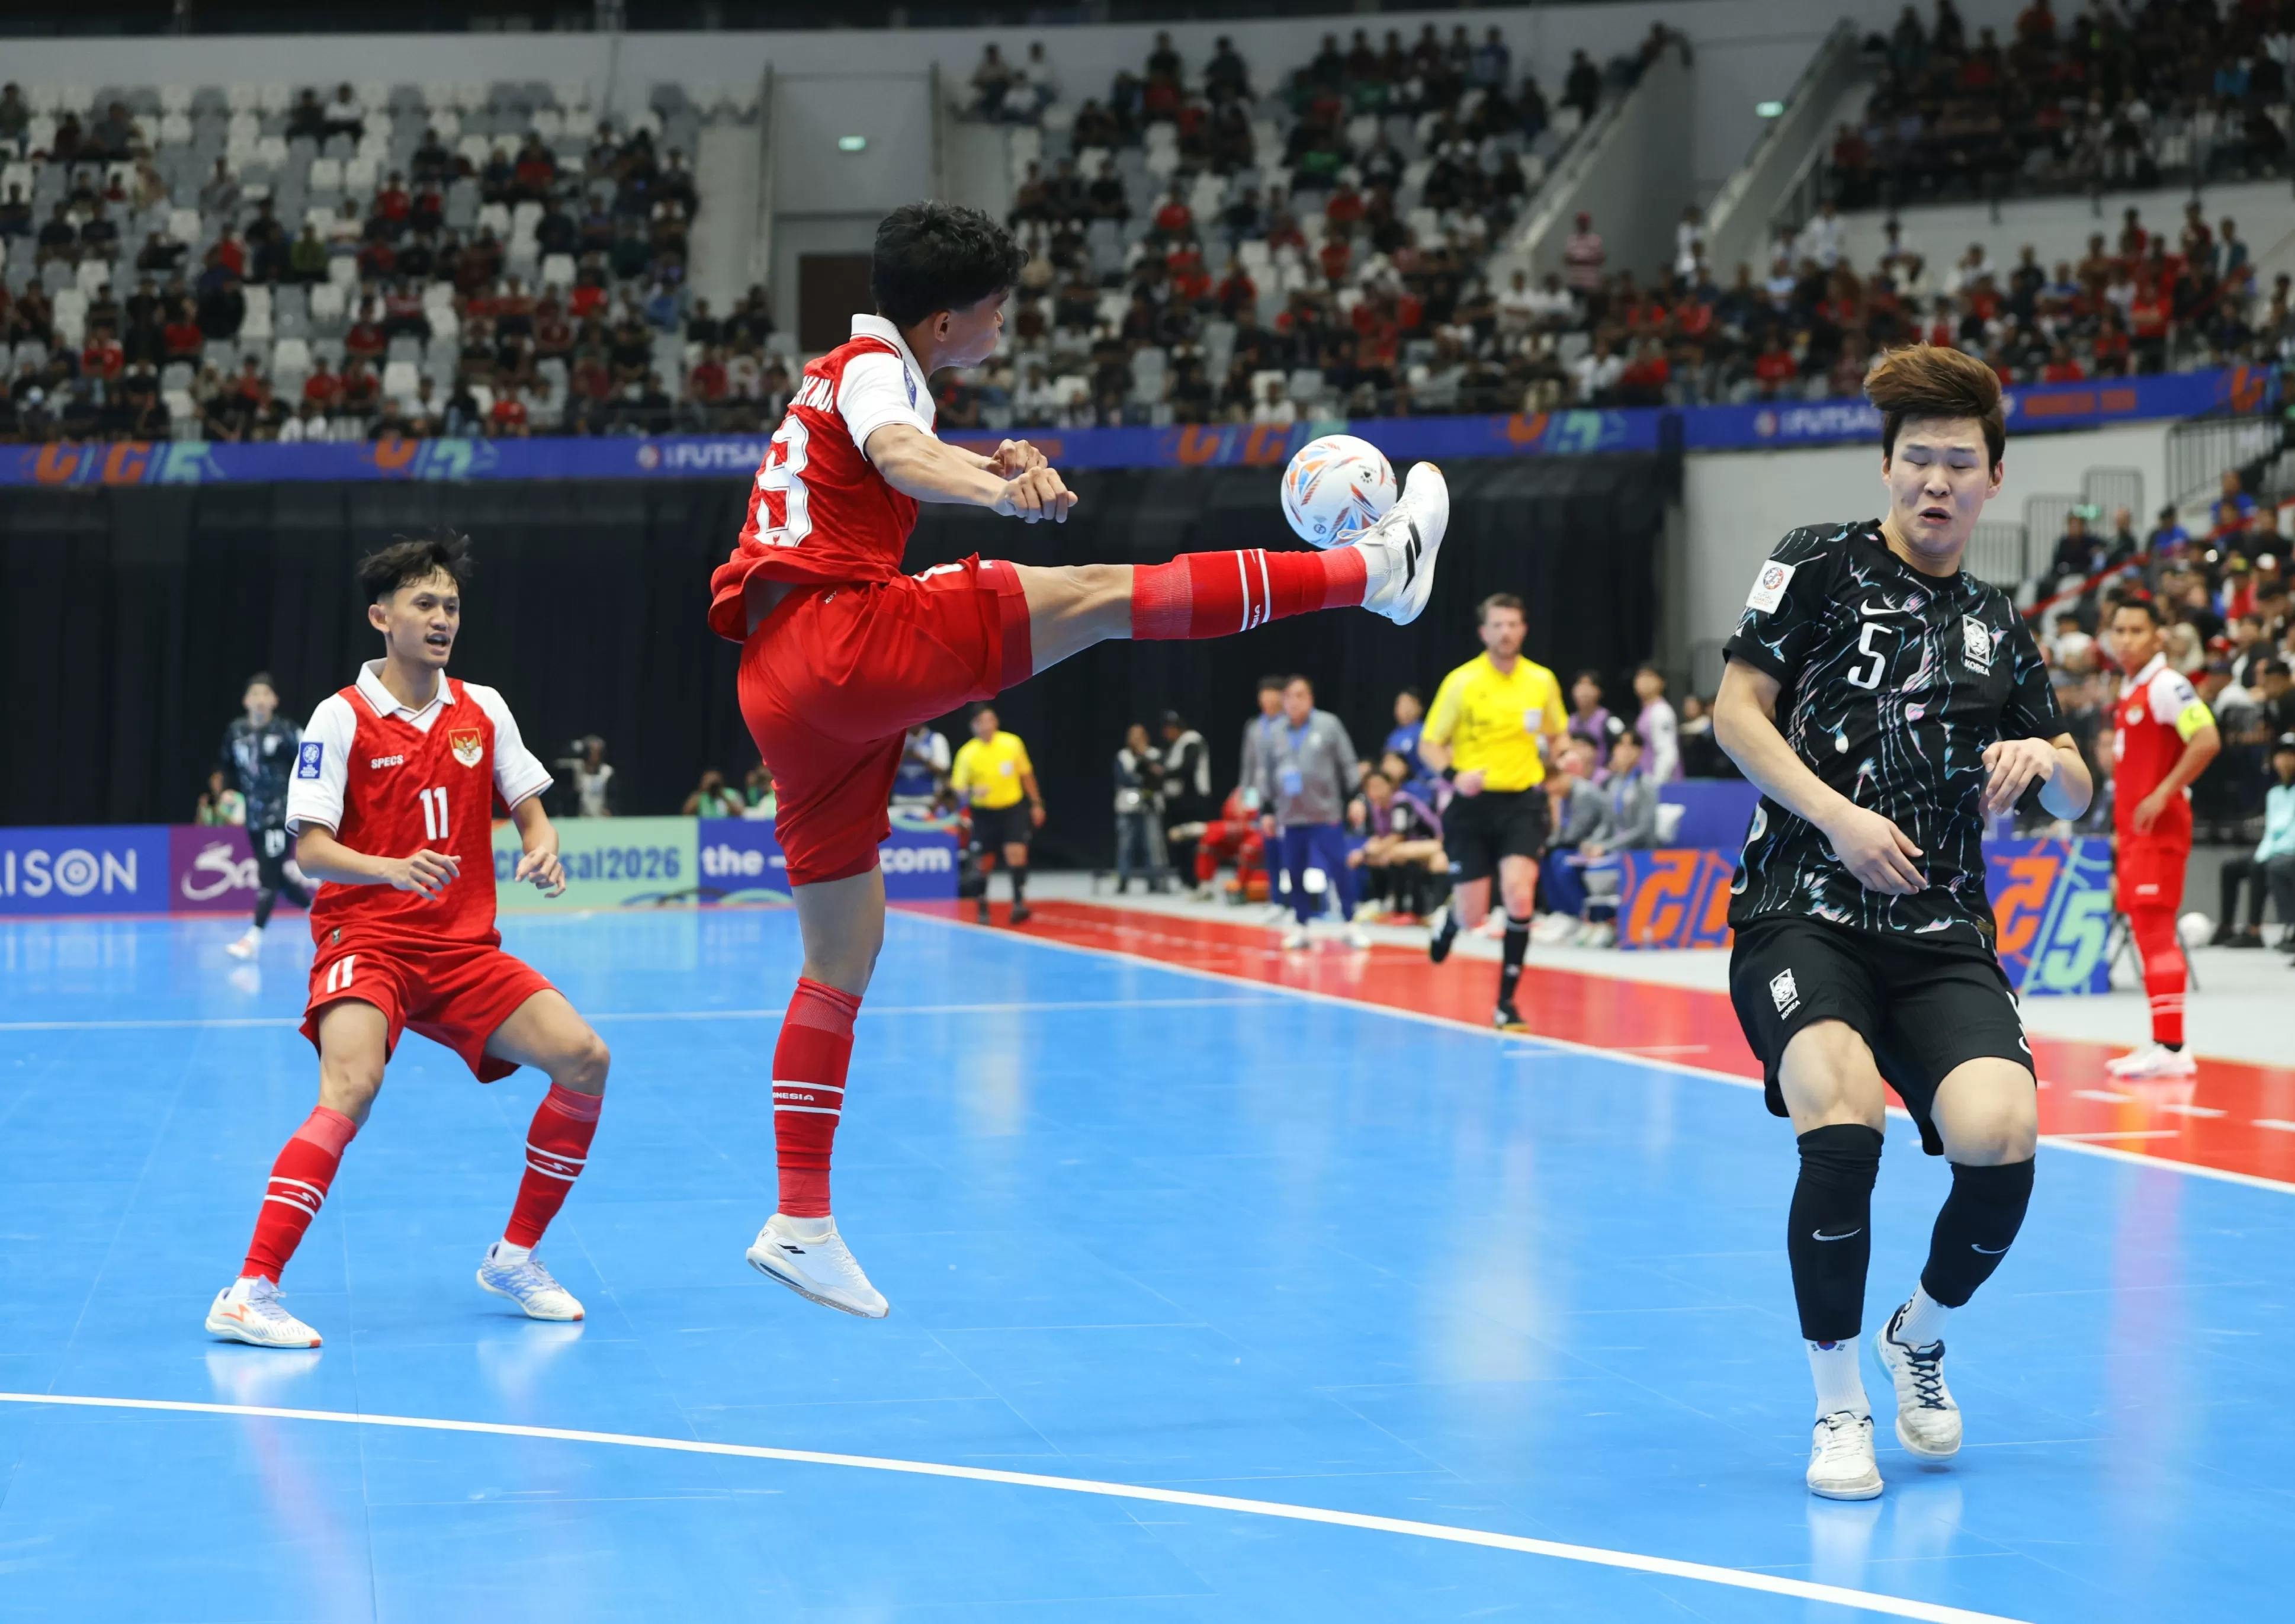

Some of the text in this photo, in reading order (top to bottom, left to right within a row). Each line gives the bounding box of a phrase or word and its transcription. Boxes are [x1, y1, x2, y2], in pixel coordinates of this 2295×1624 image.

[1848, 621, 1893, 689] 5
[1964, 659, 1990, 676] KOREA
[371, 754, 403, 769] SPECS
[419, 786, 449, 840] 11
[0, 848, 137, 898] ISON
[1781, 1000, 1801, 1020] KOREA
